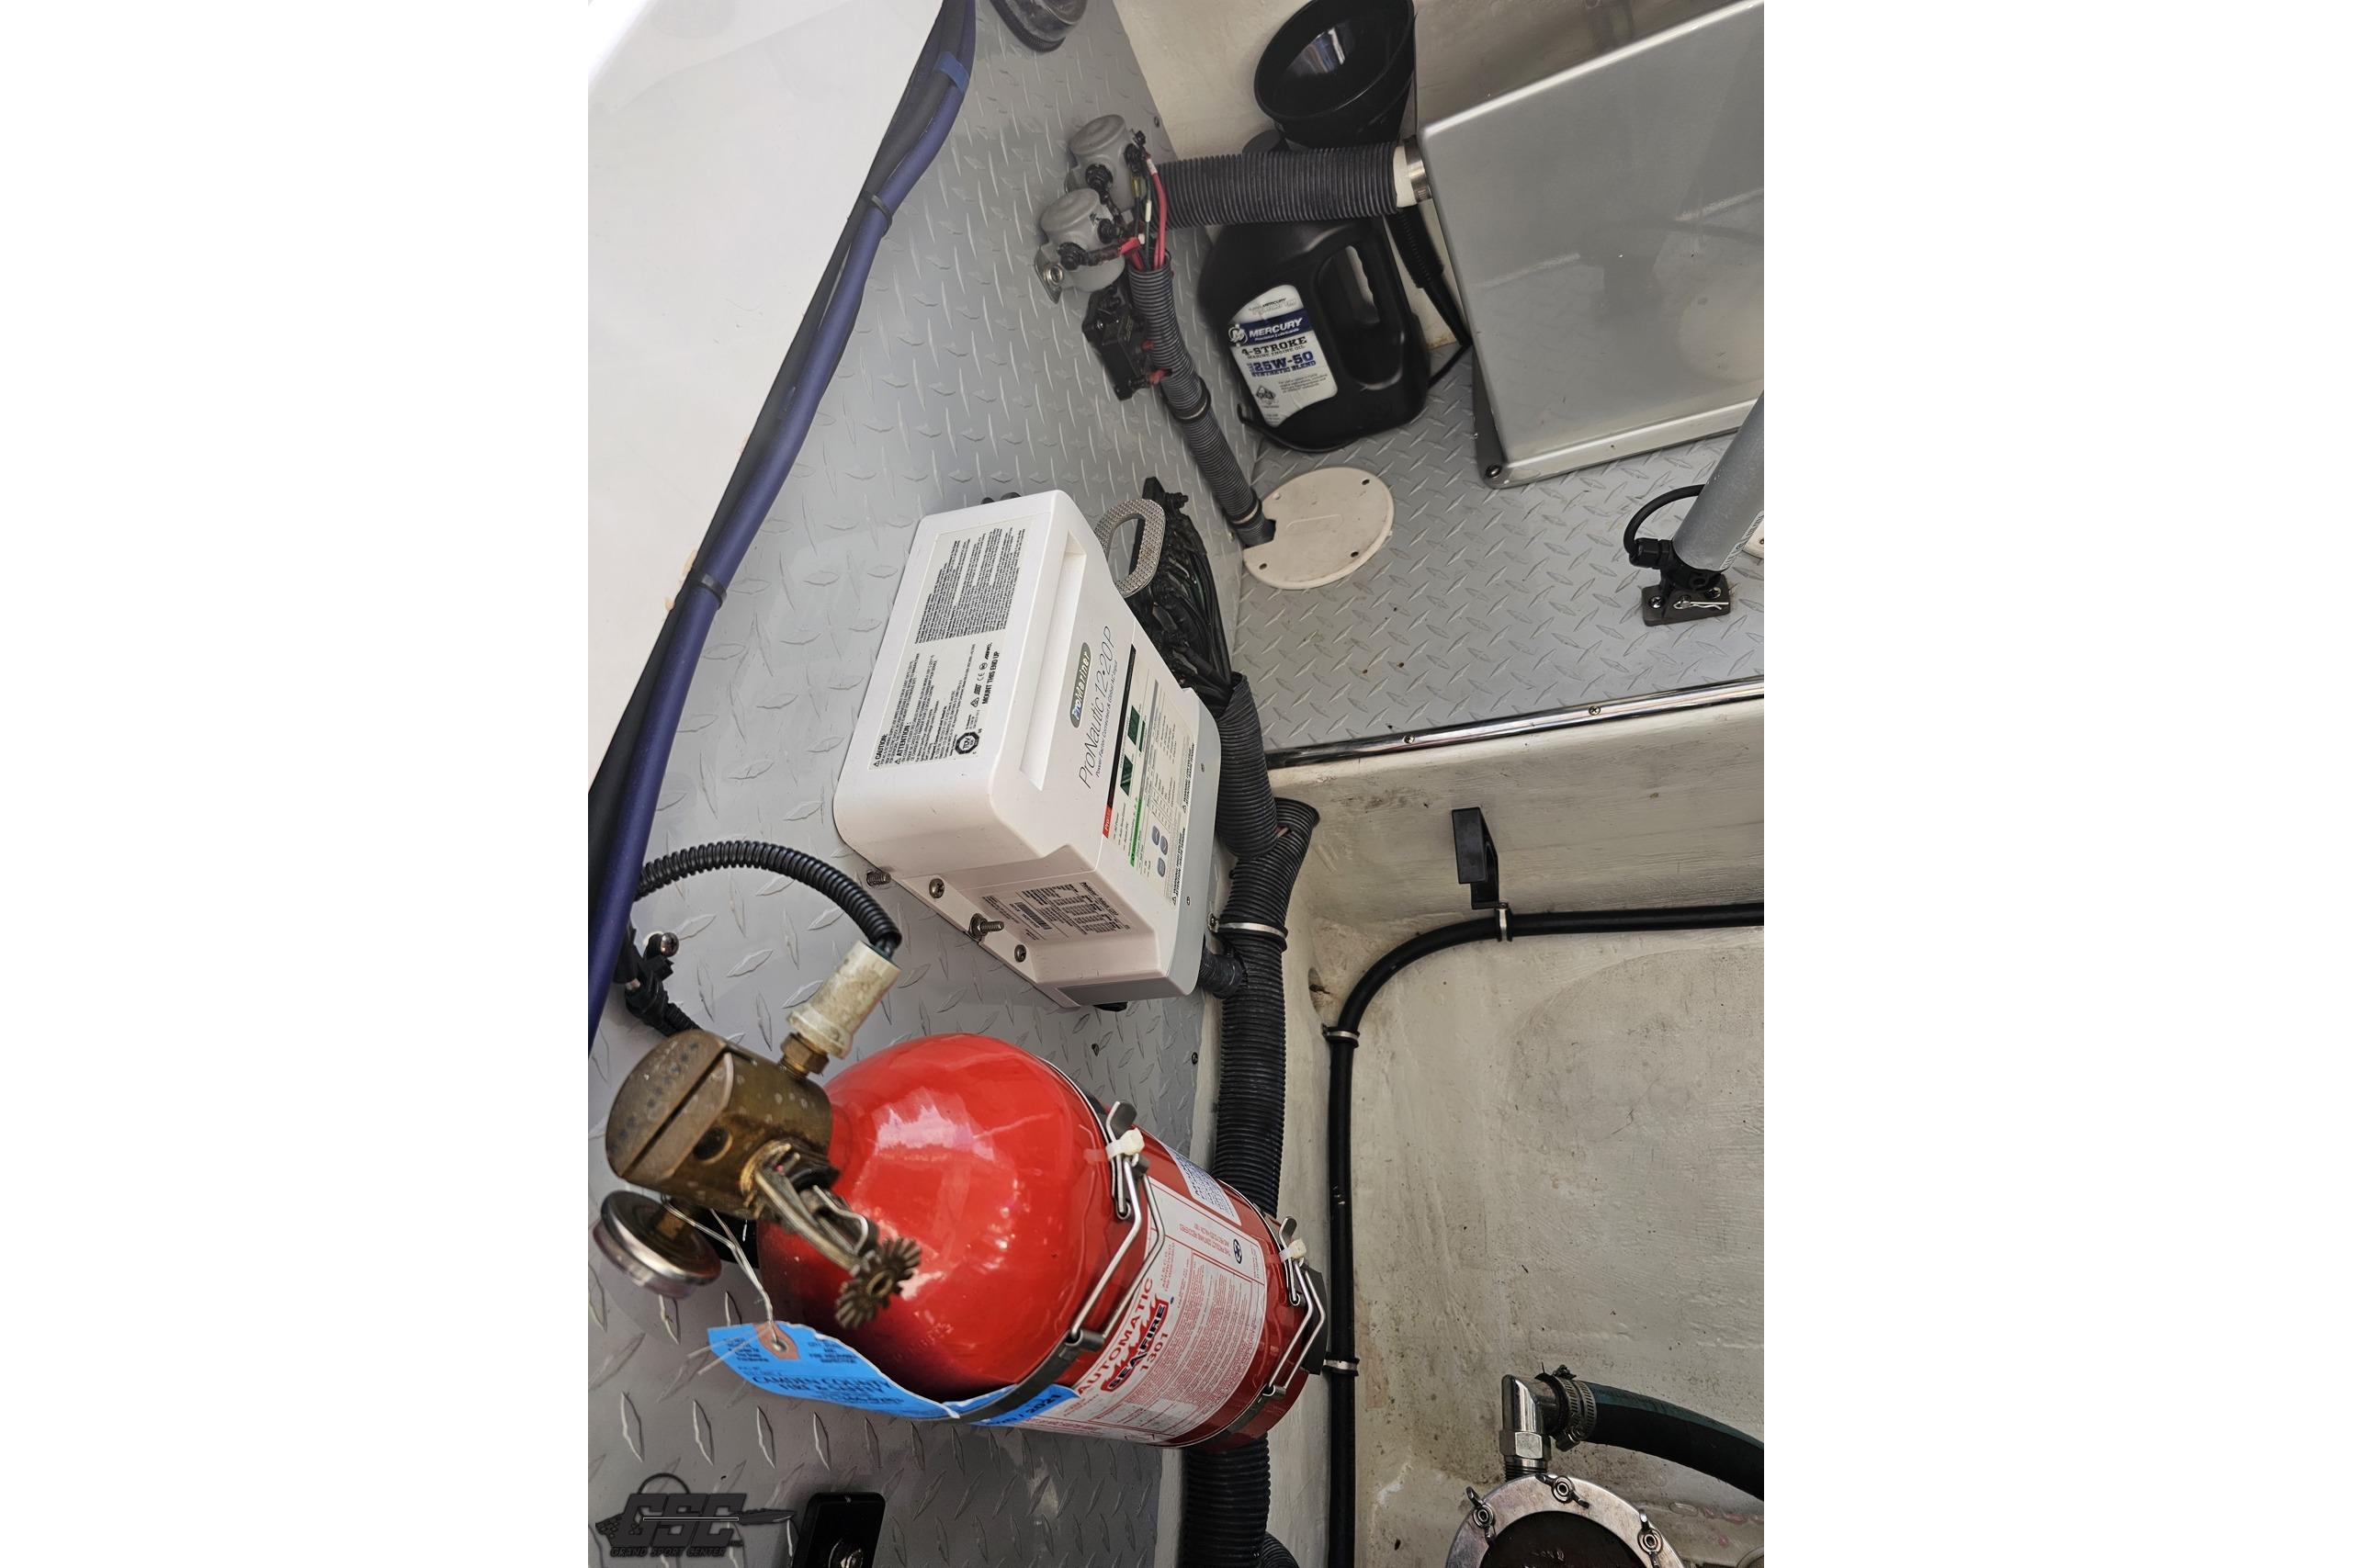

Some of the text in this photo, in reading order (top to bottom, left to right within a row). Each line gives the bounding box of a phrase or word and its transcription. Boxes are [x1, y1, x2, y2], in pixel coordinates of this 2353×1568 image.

[1249, 318, 1303, 338] MERCURY
[1241, 336, 1307, 355] 4-STROKE
[1253, 351, 1314, 372] 25W-50
[1292, 360, 1317, 372] BLEND
[989, 659, 998, 670] END
[986, 671, 995, 682] THIS
[1071, 651, 1090, 720] ProMariner
[980, 683, 992, 704] MOUNT
[876, 734, 888, 759] CAUTION:
[1079, 697, 1104, 789] ProNautic
[1076, 1278, 1153, 1394] AUTOMATIC
[1141, 1332, 1168, 1371] 1301
